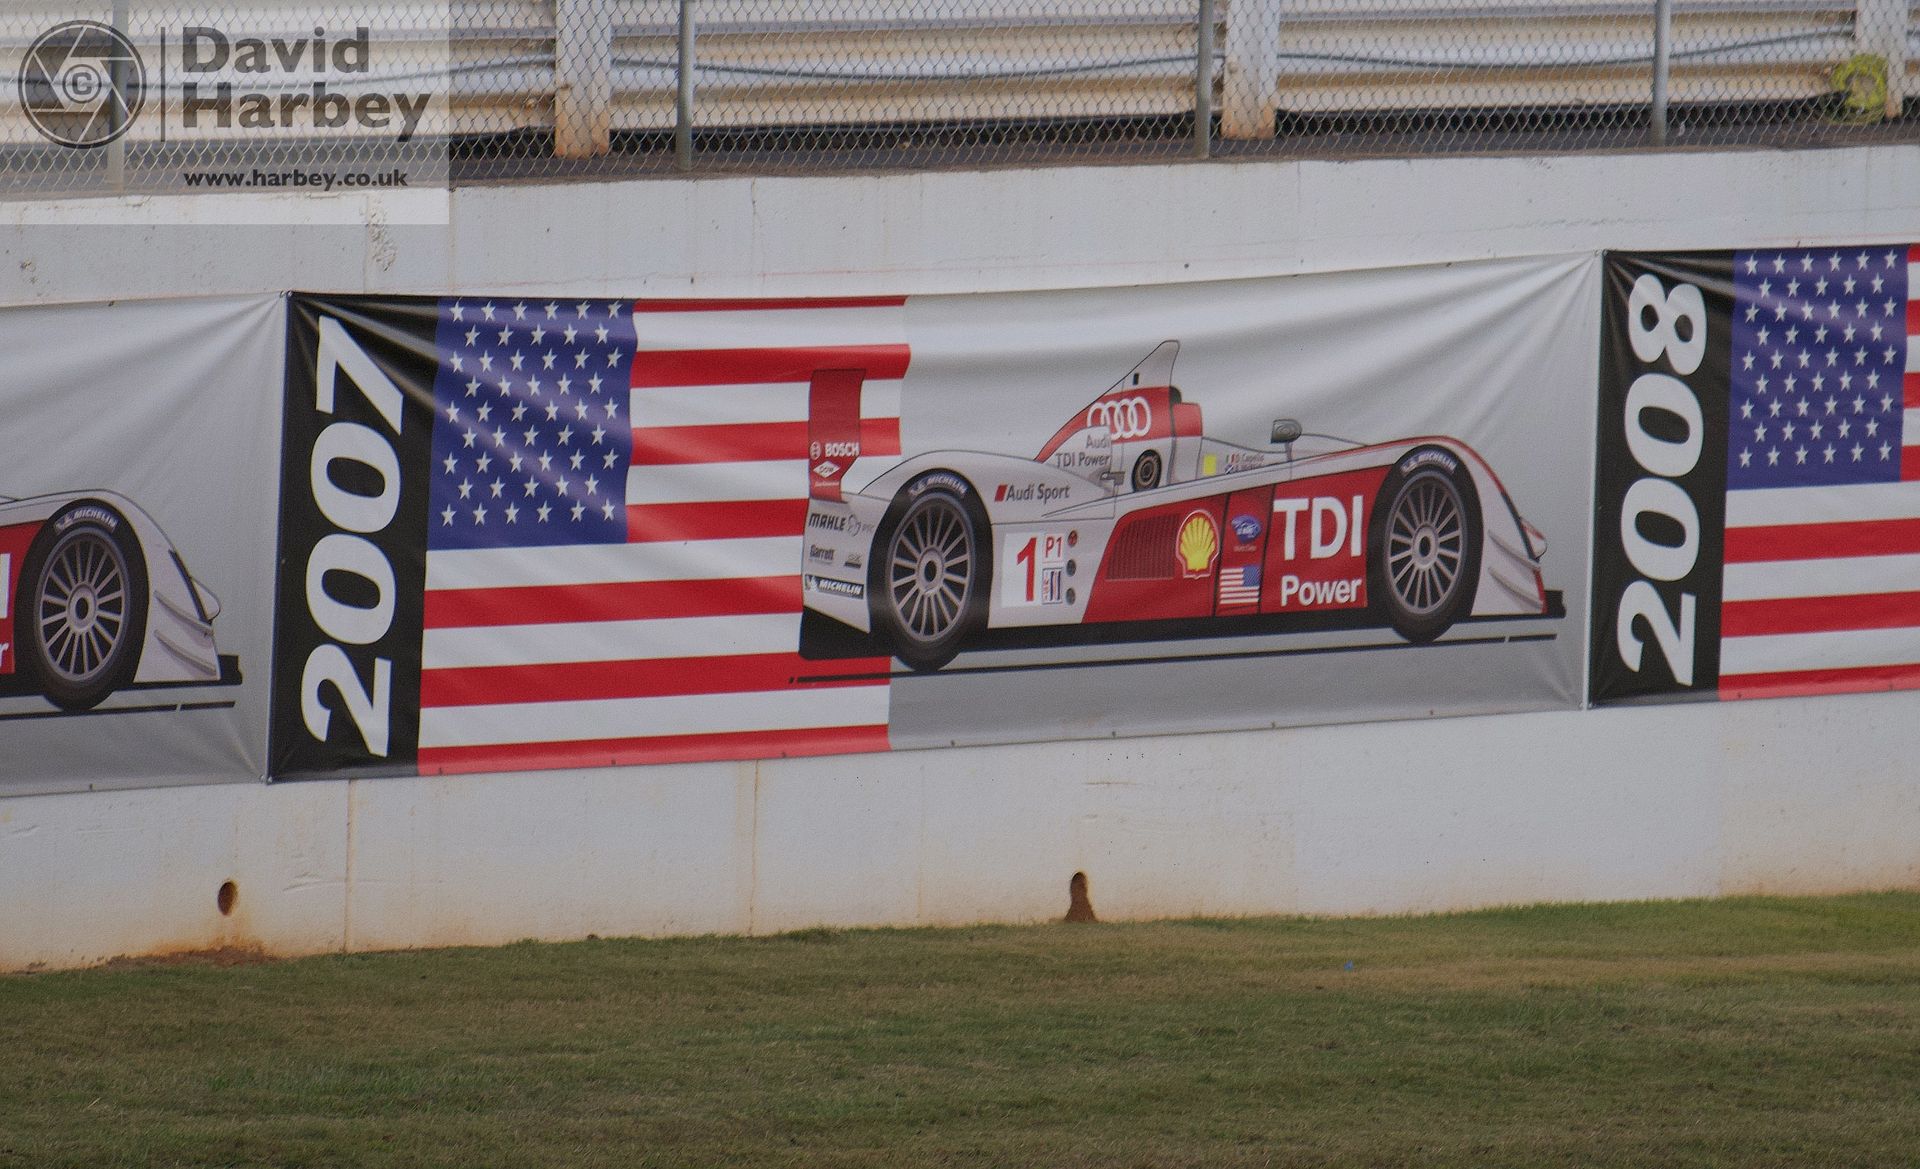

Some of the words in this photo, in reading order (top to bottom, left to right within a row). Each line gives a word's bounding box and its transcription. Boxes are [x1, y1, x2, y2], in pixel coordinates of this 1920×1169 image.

[825, 442, 860, 457] BOSCH
[1085, 434, 1111, 449] Audi
[1055, 453, 1076, 468] TDI
[1078, 452, 1111, 467] Power
[1617, 274, 1708, 686] 2008
[1006, 484, 1035, 501] Audi
[1037, 483, 1071, 505] Sport
[73, 507, 119, 528] MICHELIN
[808, 513, 846, 531] MAHLE
[1273, 496, 1364, 560] TDI
[301, 315, 404, 758] 2007
[1045, 536, 1062, 558] P1
[1016, 536, 1037, 602] 1
[819, 579, 862, 595] MICHELIN
[1281, 575, 1362, 607] Power
